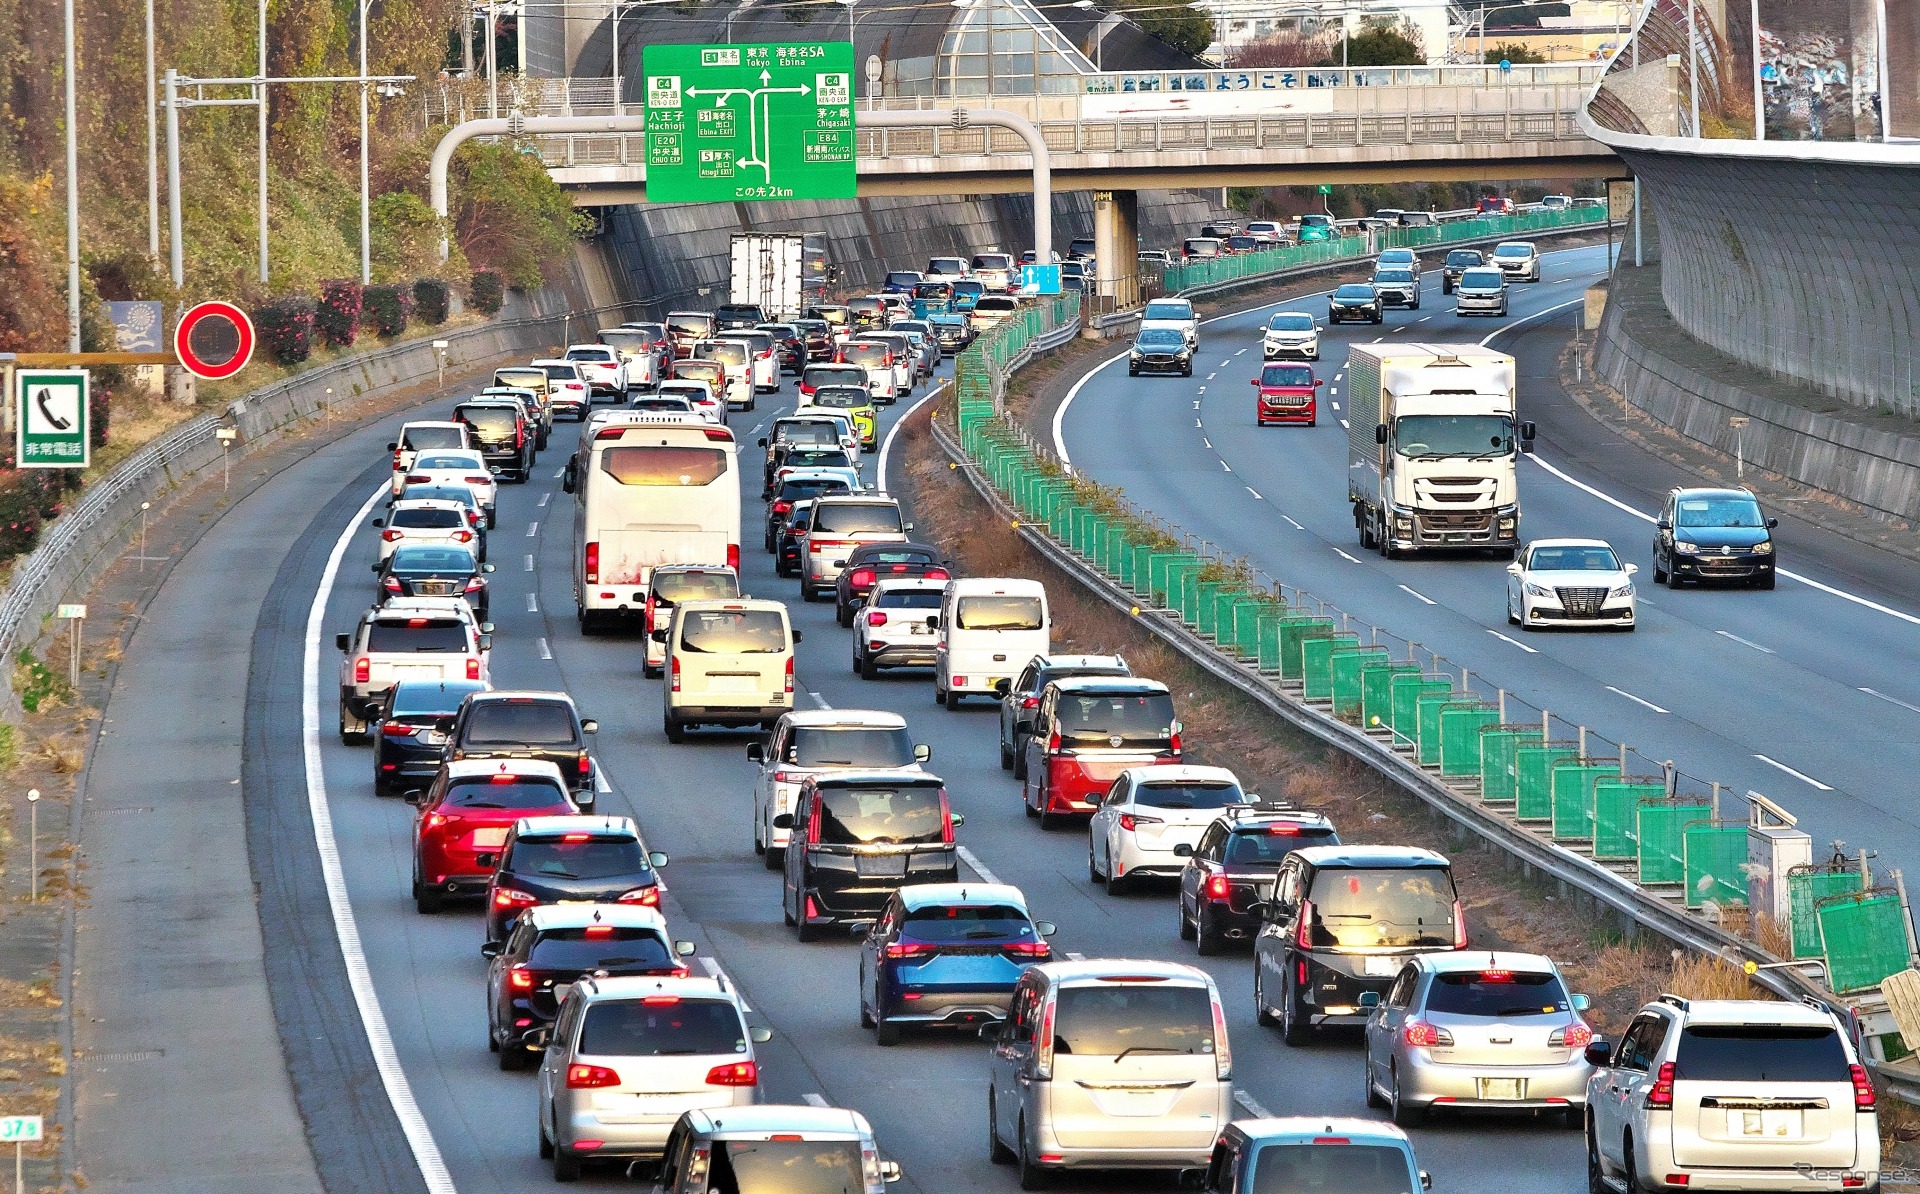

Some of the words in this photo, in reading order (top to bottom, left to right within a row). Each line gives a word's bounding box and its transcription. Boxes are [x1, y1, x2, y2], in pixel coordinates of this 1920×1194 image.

[720, 51, 738, 59] 東名
[747, 47, 769, 58] 東京
[776, 46, 825, 57] 海老名SA
[746, 58, 770, 68] Tokyo
[780, 58, 806, 66] Ebina
[658, 80, 670, 88] C4
[826, 76, 839, 85] C4
[1216, 73, 1297, 90] ようこそ
[649, 111, 684, 121] 八王子
[700, 112, 710, 120] 31
[712, 111, 733, 120] 海老名
[648, 121, 685, 131] Hachioji
[817, 118, 851, 128] Chigasaki
[657, 136, 675, 145] E20
[819, 134, 837, 142] E84
[652, 147, 680, 156] 中央道
[714, 151, 732, 160] 厚木
[25, 441, 82, 456] 非常電話
